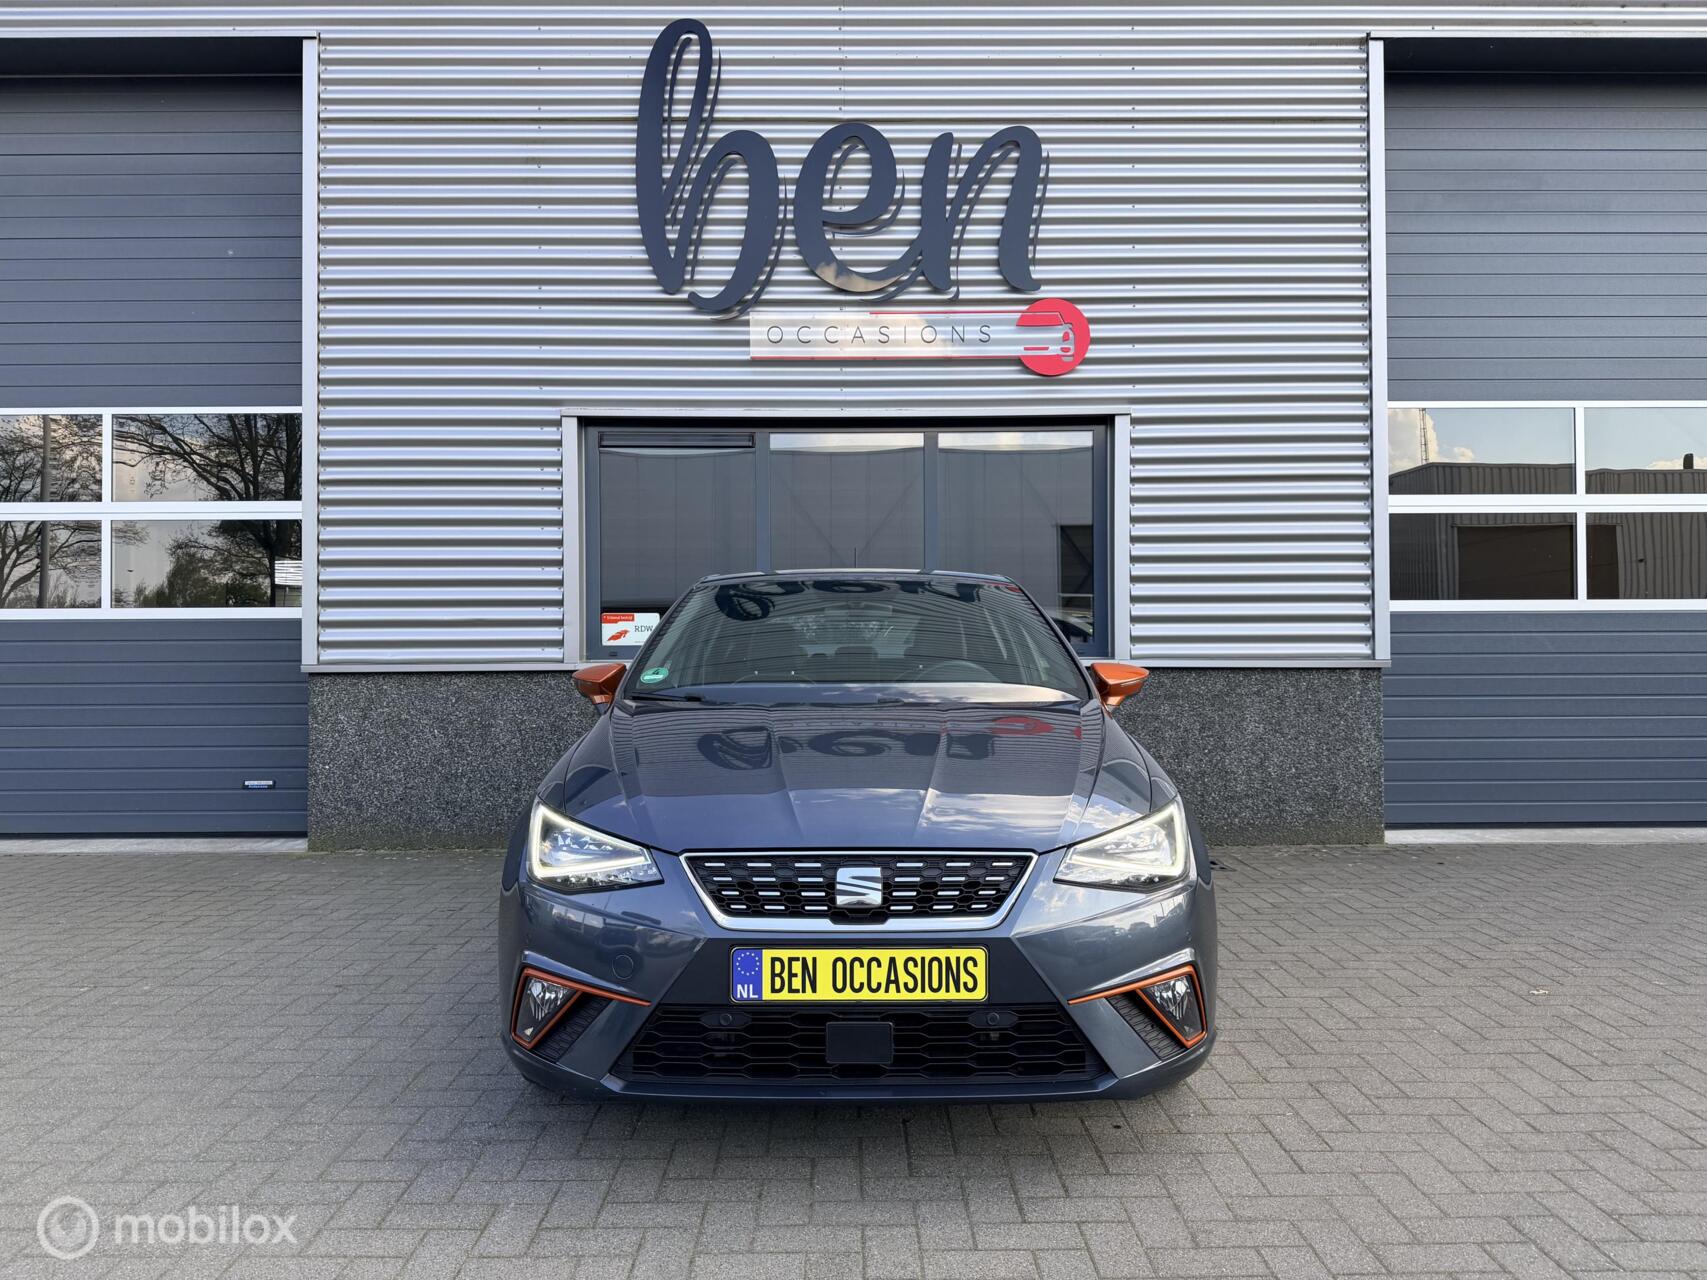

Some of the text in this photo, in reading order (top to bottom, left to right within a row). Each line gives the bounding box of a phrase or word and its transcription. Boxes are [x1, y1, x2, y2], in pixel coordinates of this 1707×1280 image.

[635, 17, 1050, 321] ben
[766, 323, 991, 344] OCCASIONS
[634, 625, 654, 633] RDW
[770, 956, 979, 994] BEN OCCASIONS
[736, 983, 759, 998] NL
